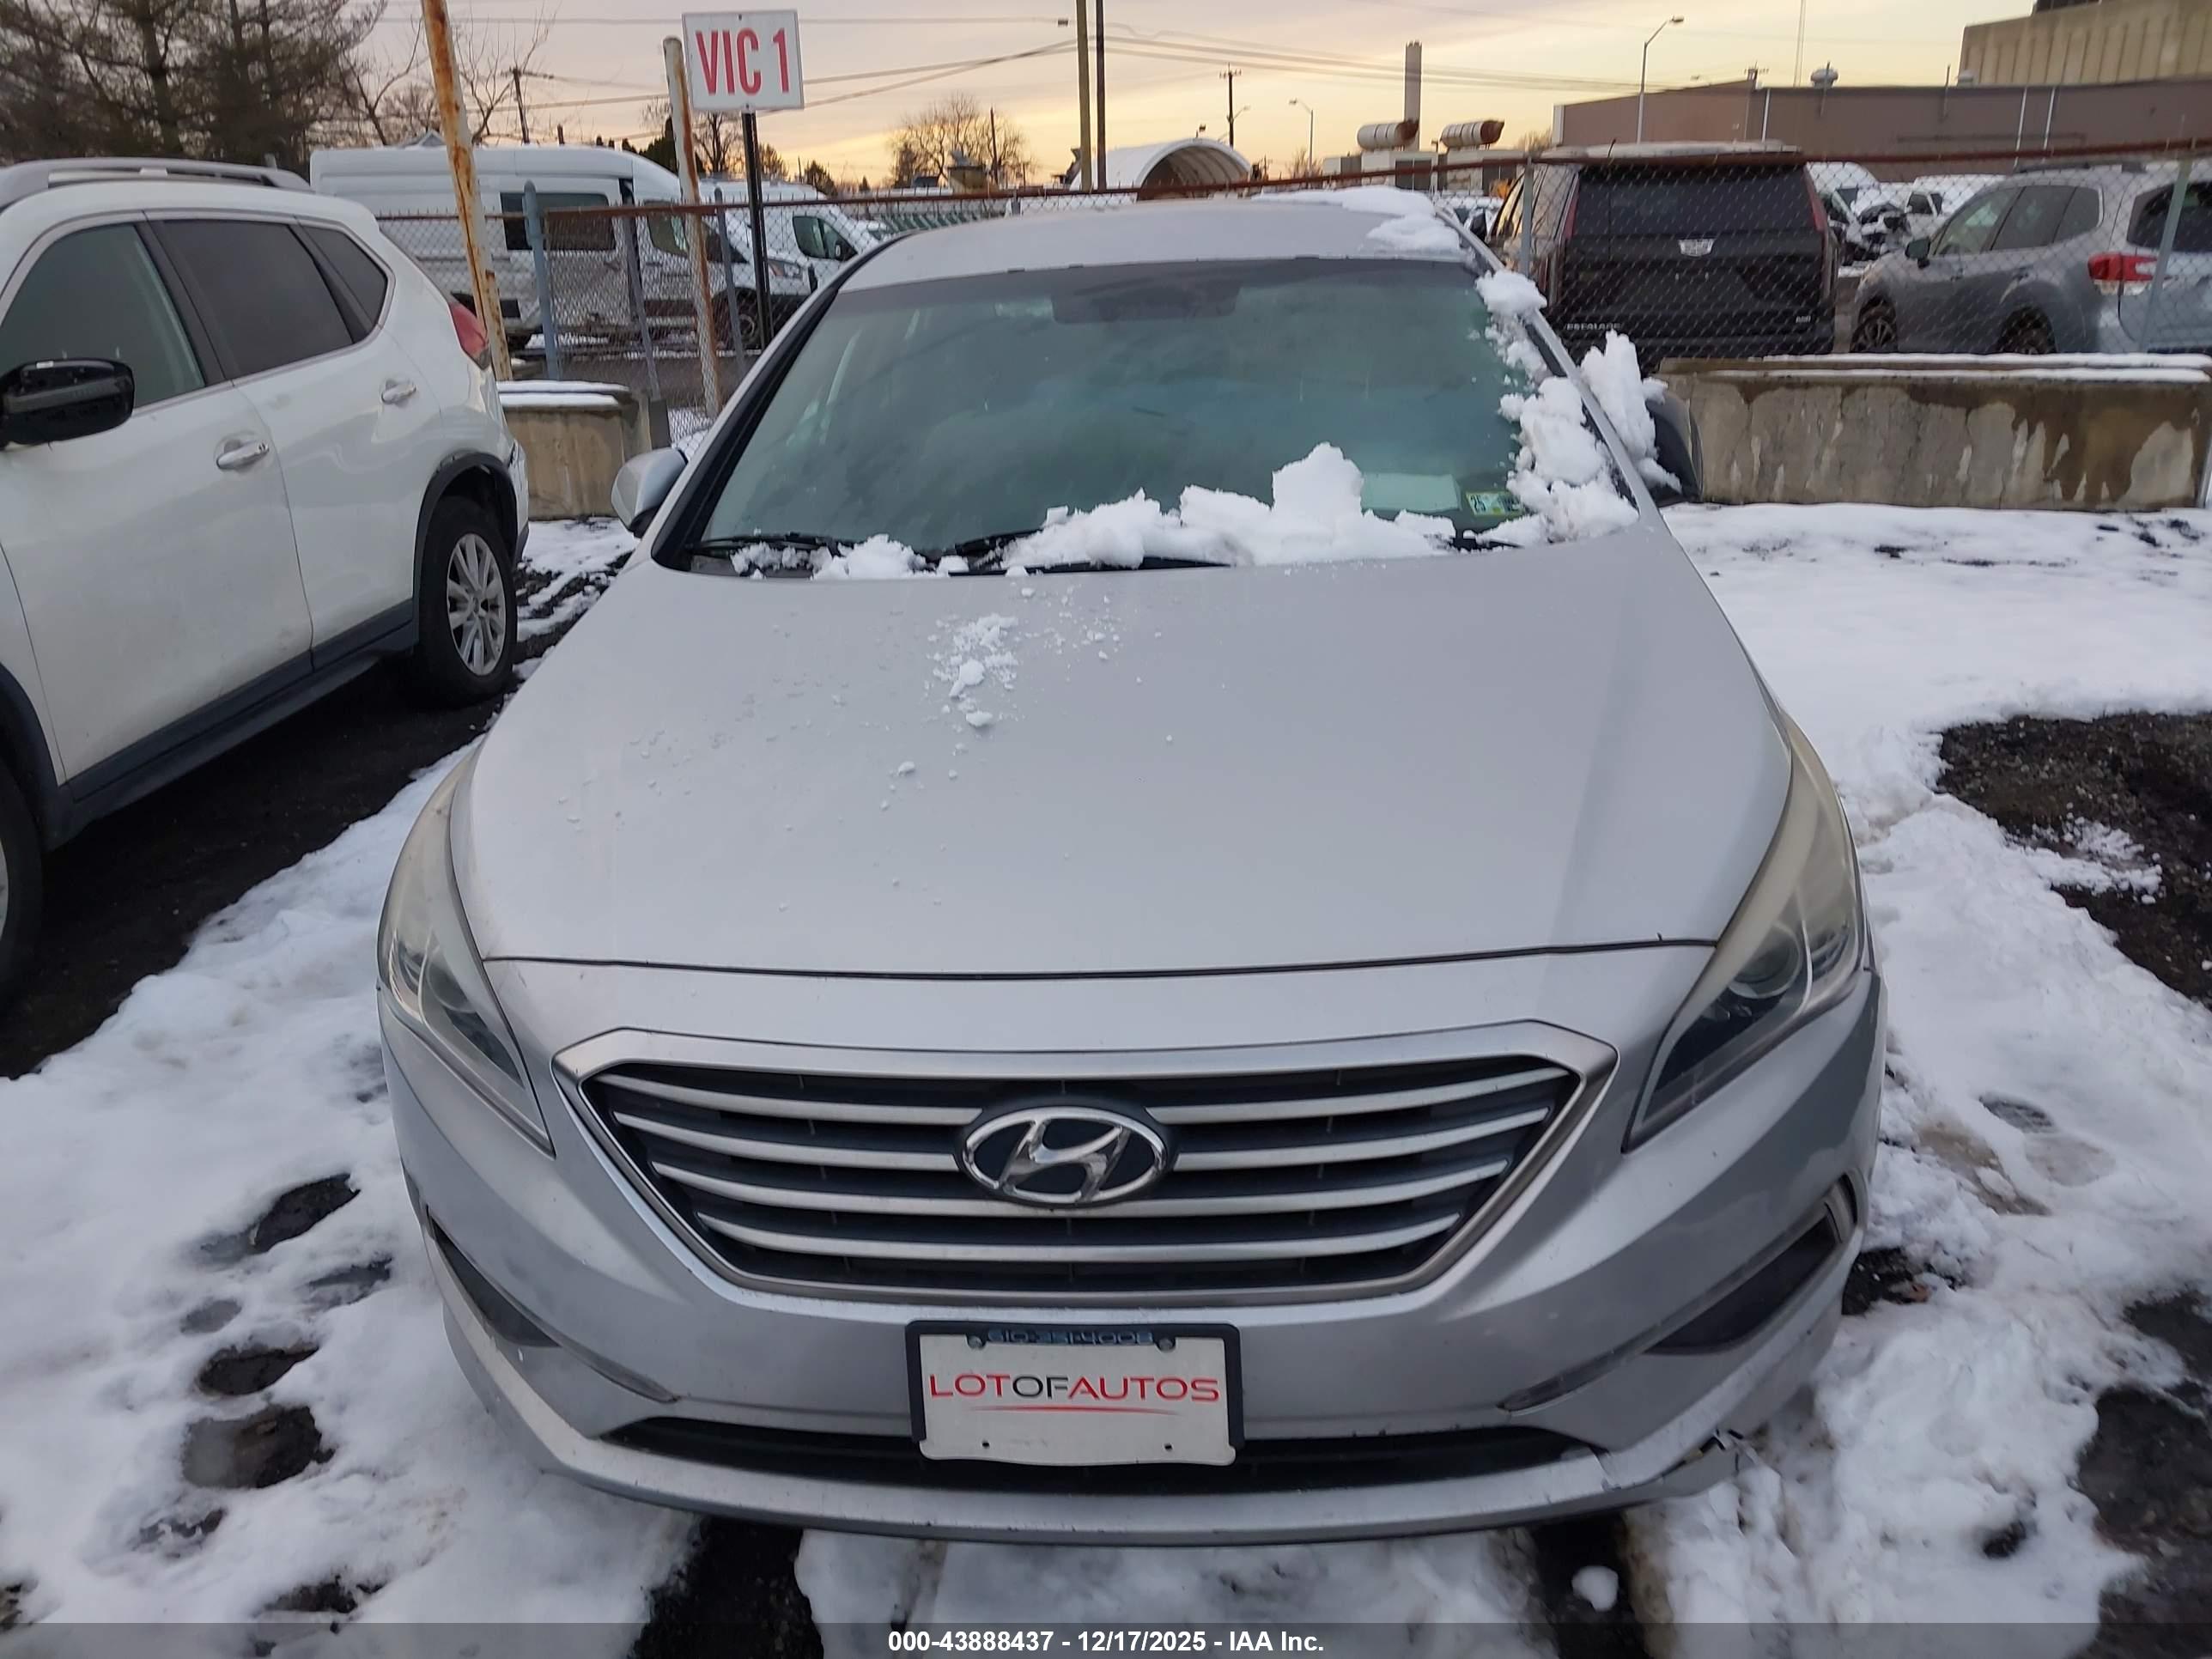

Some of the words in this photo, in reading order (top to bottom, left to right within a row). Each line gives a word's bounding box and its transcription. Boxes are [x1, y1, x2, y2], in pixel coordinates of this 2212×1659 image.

[696, 27, 762, 96] VIC
[772, 27, 789, 94] 1
[929, 1373, 1220, 1402] LOTOFAUTOS
